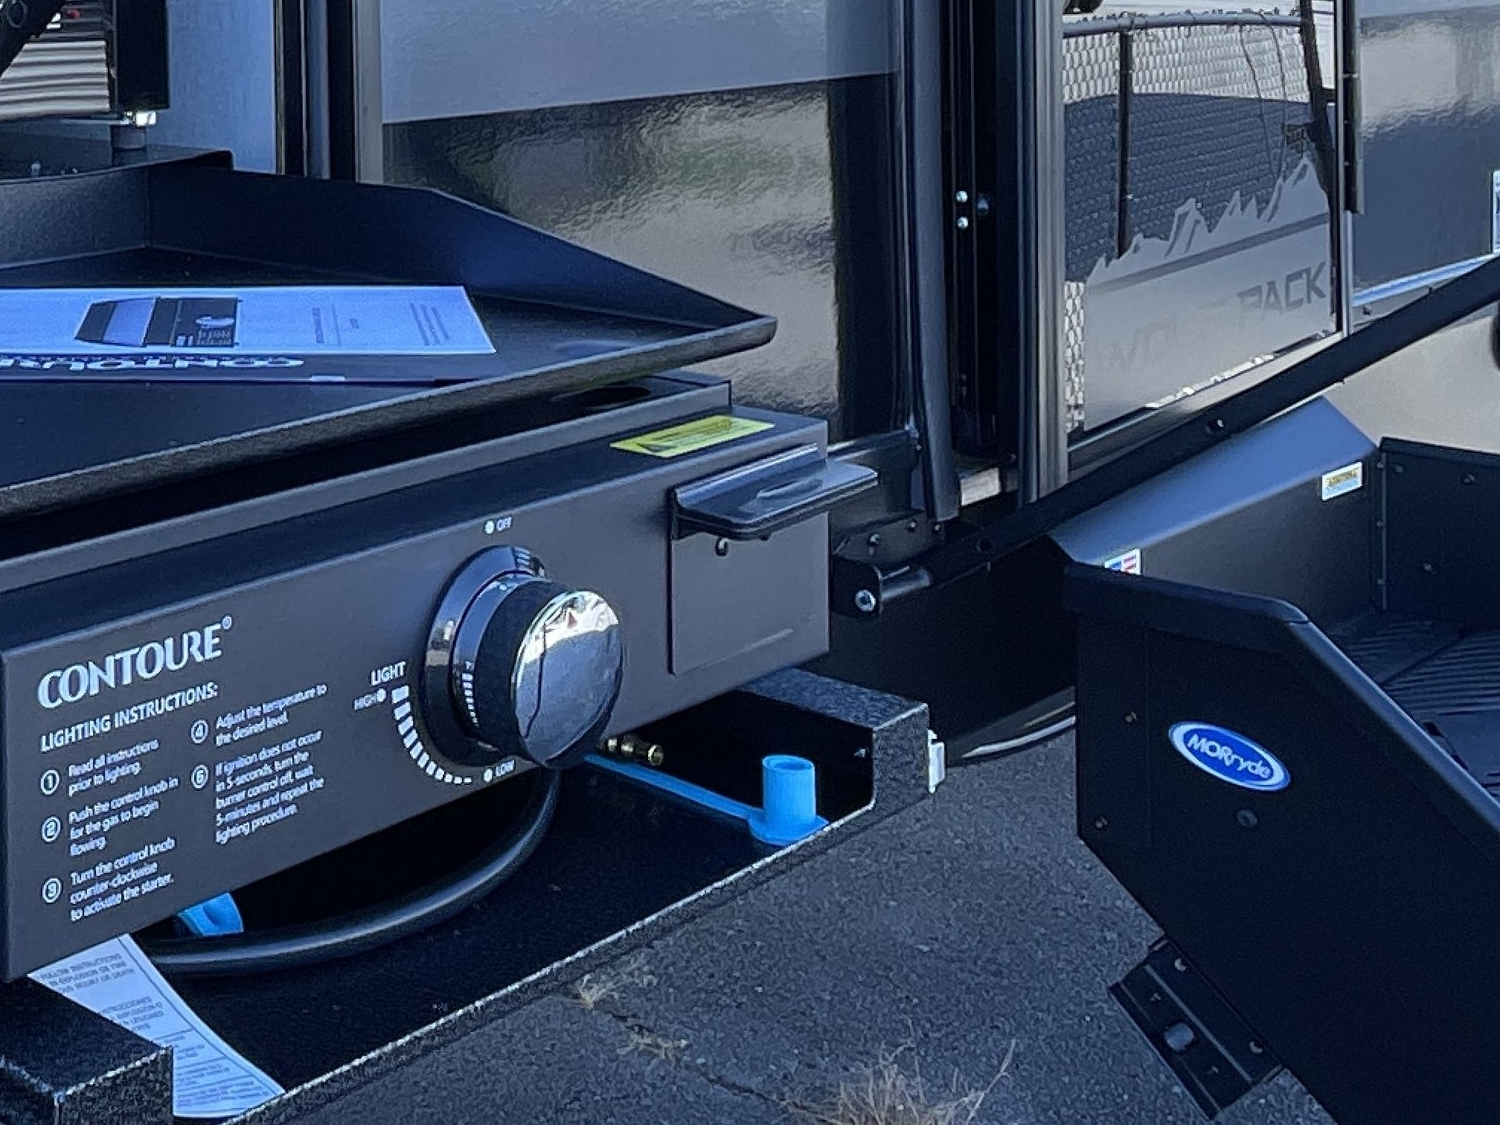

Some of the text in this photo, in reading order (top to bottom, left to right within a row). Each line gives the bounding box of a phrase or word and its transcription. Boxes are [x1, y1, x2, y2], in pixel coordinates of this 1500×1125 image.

[37, 622, 222, 709] CONTOURE
[371, 661, 406, 686] LIGHT
[40, 681, 219, 753] LIGHTING INSTRUCTIONS:
[216, 710, 245, 729] Adjust
[246, 706, 261, 718] the
[262, 687, 316, 714] temperature
[316, 684, 327, 696] to
[216, 732, 231, 746] the
[233, 718, 266, 740] desired
[69, 758, 93, 777] Read
[94, 754, 105, 767] all
[106, 739, 160, 764] instructions
[215, 762, 222, 776] If
[223, 753, 258, 775] ignition
[258, 745, 280, 761] does
[282, 738, 297, 752] not
[216, 780, 225, 792] in
[274, 757, 293, 772] turn
[294, 751, 309, 764] the
[495, 759, 515, 777] LOW
[1187, 733, 1272, 779] MORryde
[69, 777, 92, 797] prior
[93, 774, 104, 786] to
[69, 805, 93, 824] Push
[94, 802, 110, 815] the
[111, 787, 143, 809] control
[144, 780, 168, 796] knob
[168, 777, 179, 788] in
[216, 790, 246, 809] burner
[247, 775, 279, 797] control
[262, 791, 280, 808] and
[280, 782, 308, 802] repeat
[309, 777, 324, 792] the
[70, 800, 160, 840] for the gas to begin
[216, 821, 250, 844] lighting
[70, 870, 94, 885] Turn
[95, 861, 113, 876] the
[113, 845, 148, 869] control
[149, 836, 176, 856] knob
[70, 908, 83, 921] to
[84, 893, 122, 917] activate
[123, 885, 140, 901] the
